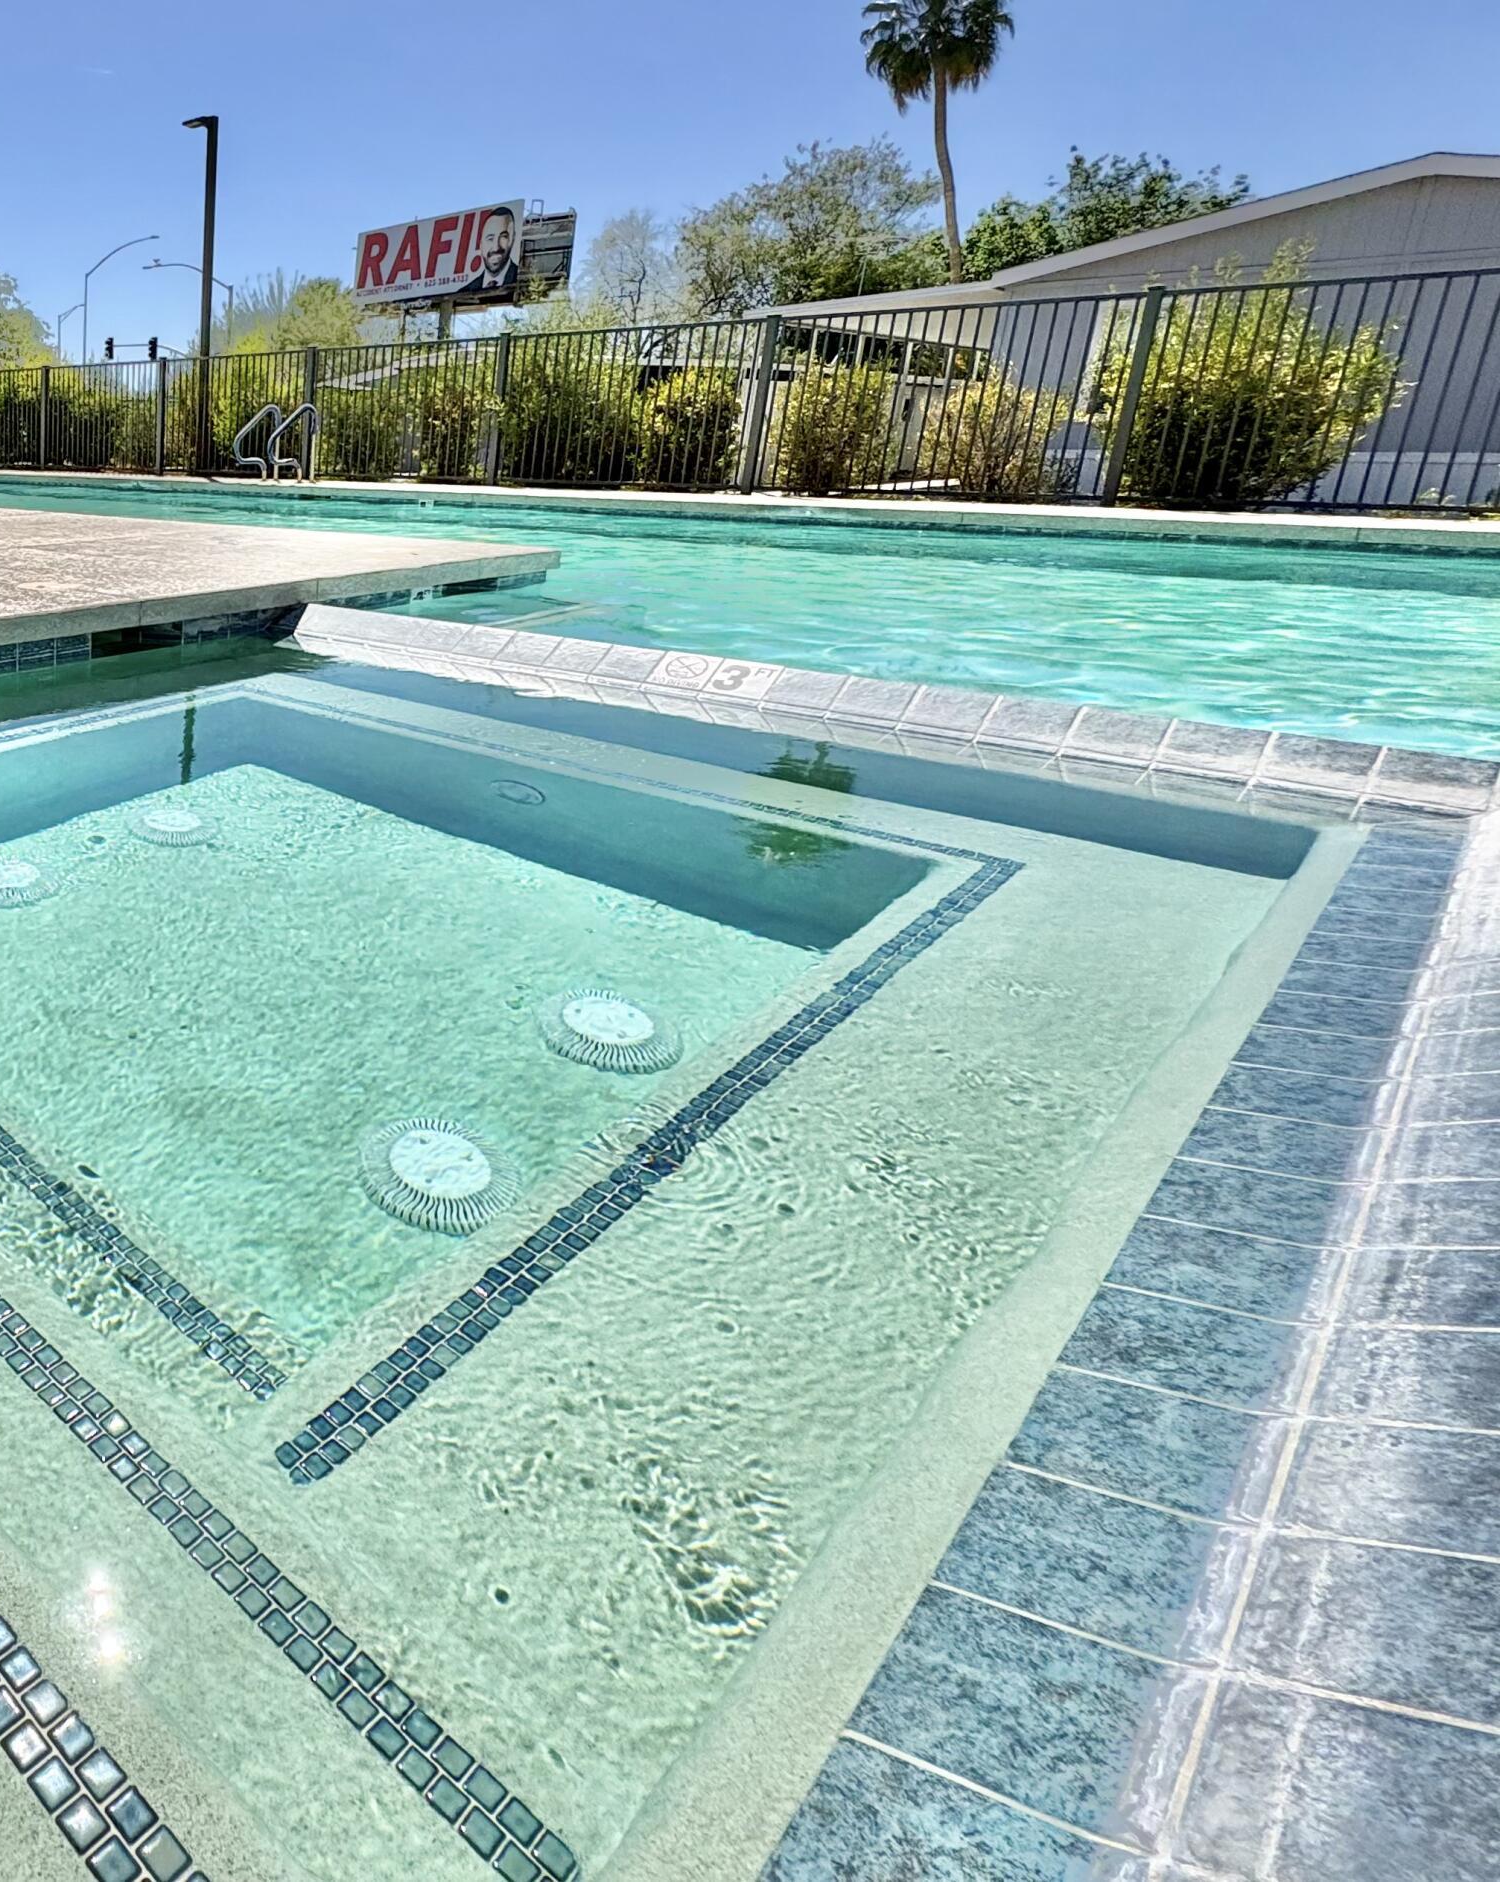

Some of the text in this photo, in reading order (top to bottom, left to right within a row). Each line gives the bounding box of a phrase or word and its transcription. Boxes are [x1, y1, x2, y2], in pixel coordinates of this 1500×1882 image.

[357, 208, 493, 290] RAFI!
[711, 665, 779, 691] 3 FT
